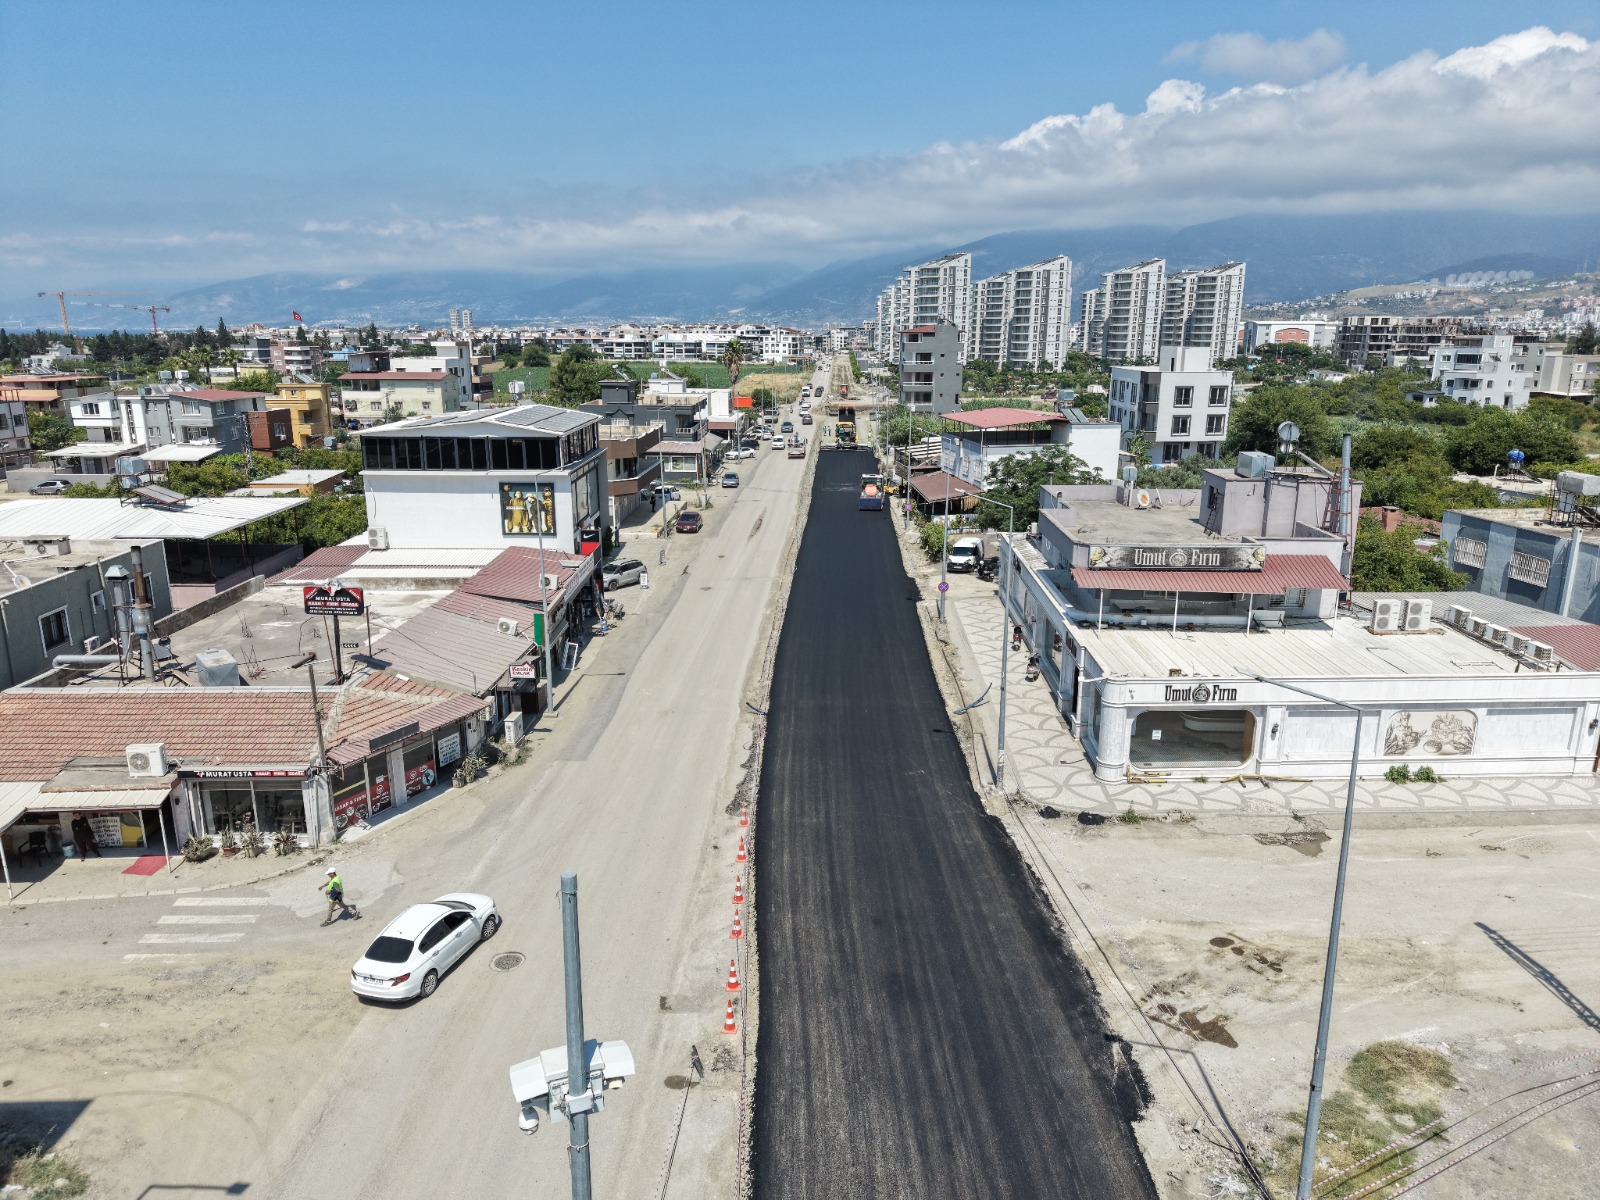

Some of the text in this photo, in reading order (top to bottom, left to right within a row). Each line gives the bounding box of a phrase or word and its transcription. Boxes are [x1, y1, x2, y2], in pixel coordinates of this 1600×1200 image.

[1134, 548, 1220, 566] Umut Fırın
[1165, 684, 1238, 701] Umut Fırın
